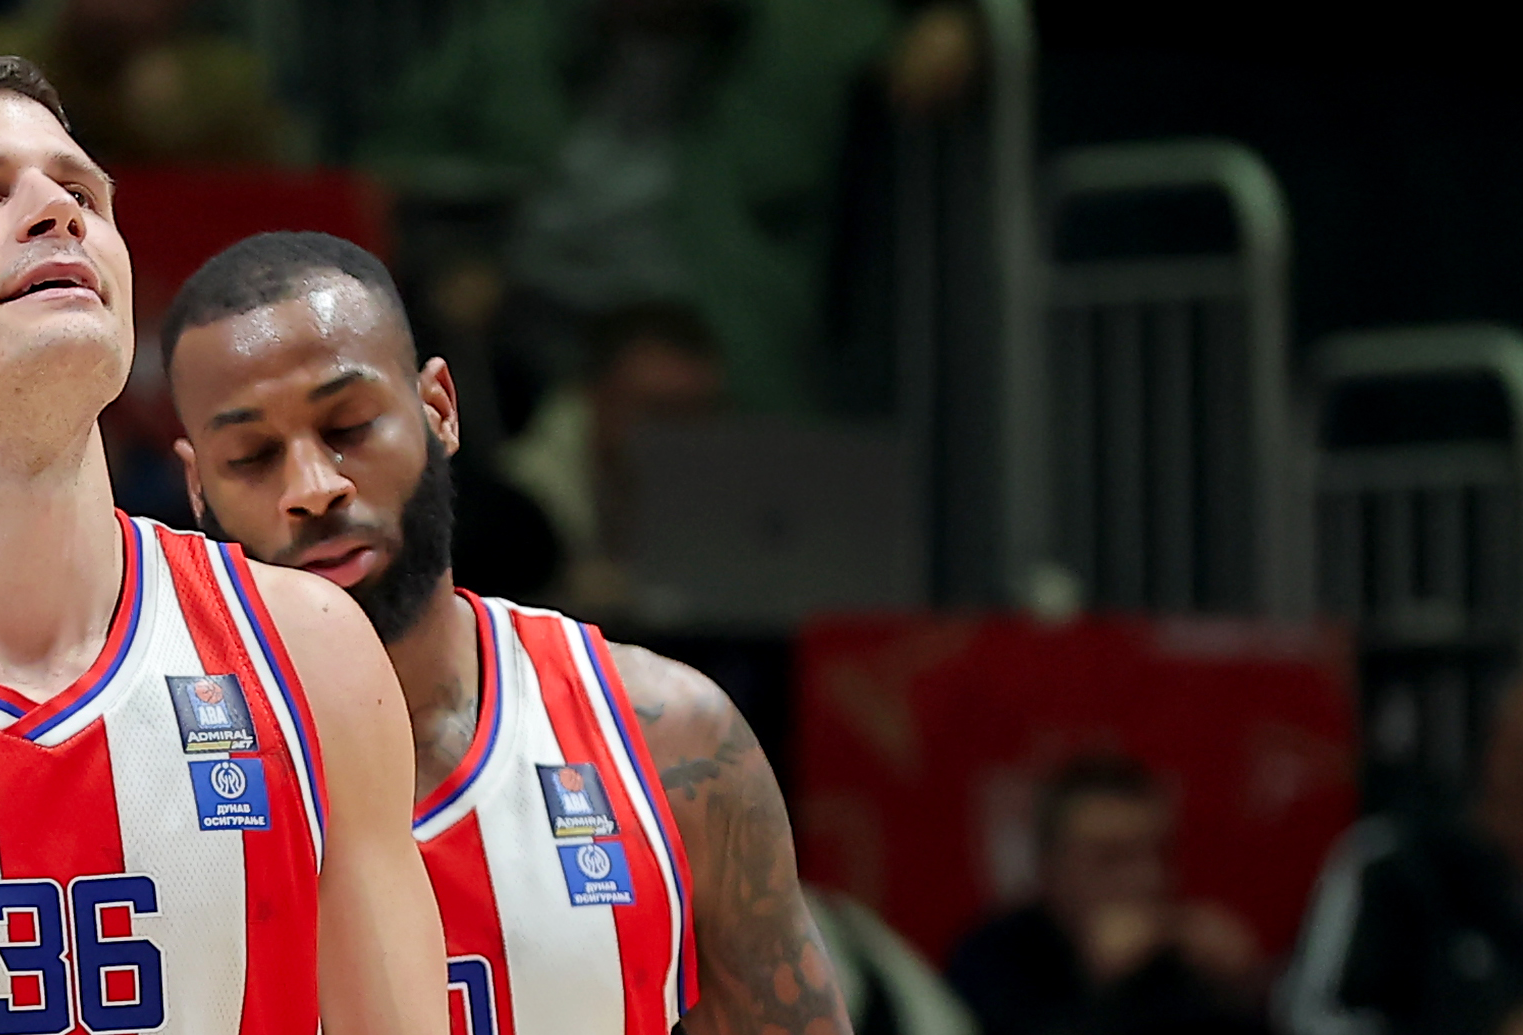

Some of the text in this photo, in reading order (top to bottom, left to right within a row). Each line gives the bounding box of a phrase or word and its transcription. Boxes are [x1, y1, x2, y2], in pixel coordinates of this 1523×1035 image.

[198, 705, 227, 726] ABA
[188, 729, 253, 742] ADMIRAL
[217, 804, 250, 815] ДУНАВ
[204, 816, 265, 826] ОСИГУРАЊЕ
